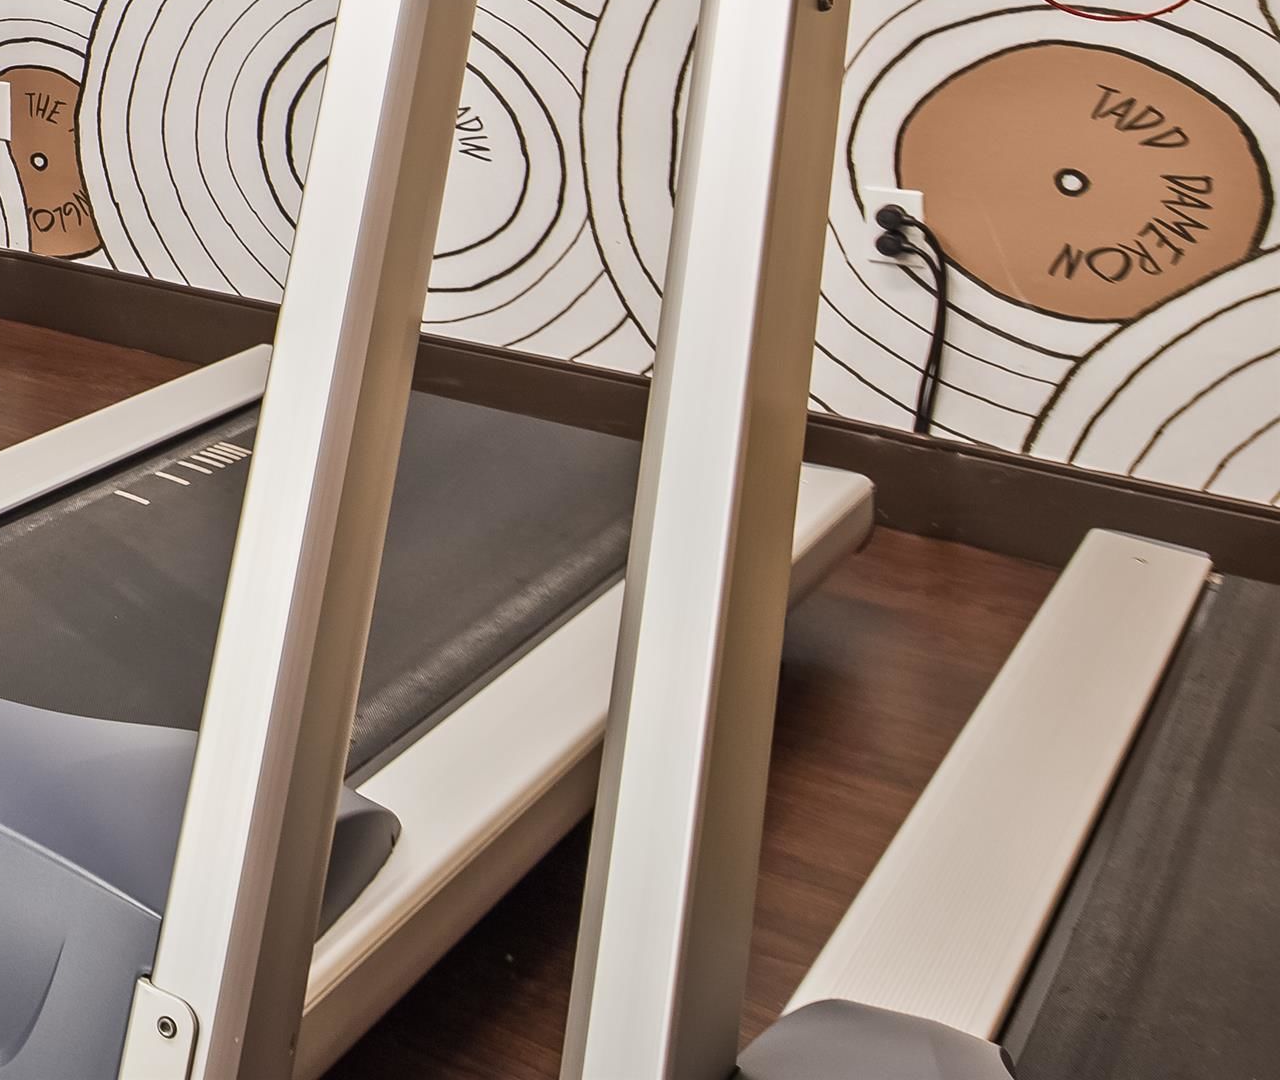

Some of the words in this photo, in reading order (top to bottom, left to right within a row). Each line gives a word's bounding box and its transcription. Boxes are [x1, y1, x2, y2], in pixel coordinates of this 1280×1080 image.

[24, 92, 67, 124] THE
[1091, 83, 1190, 149] TADD
[1047, 174, 1213, 285] DAMERON
